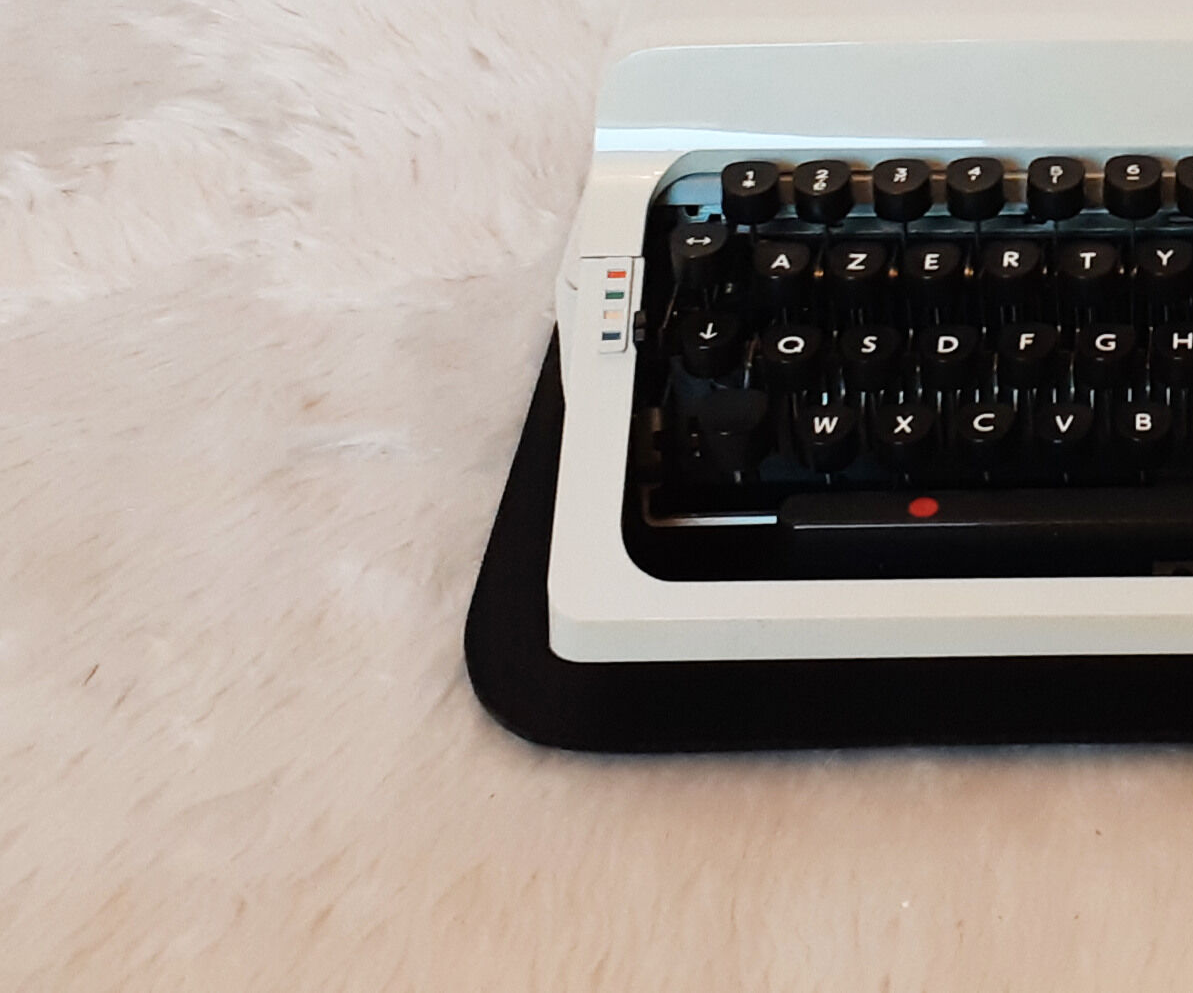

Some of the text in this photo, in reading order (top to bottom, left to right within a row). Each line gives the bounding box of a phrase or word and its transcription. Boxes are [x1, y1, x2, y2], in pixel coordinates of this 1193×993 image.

[770, 253, 791, 270] A
[846, 253, 868, 271] Z
[923, 253, 940, 271] E
[1002, 251, 1020, 268] R
[1079, 252, 1097, 269] T
[1156, 249, 1174, 266] Y
[861, 336, 878, 353] S
[937, 335, 959, 353] D
[1019, 333, 1035, 350] F
[1095, 333, 1117, 351] G
[1172, 332, 1193, 350] H
[814, 416, 839, 434] W
[893, 415, 914, 434] X
[973, 413, 996, 432] C
[1055, 415, 1074, 432] V
[1135, 413, 1152, 431] B
